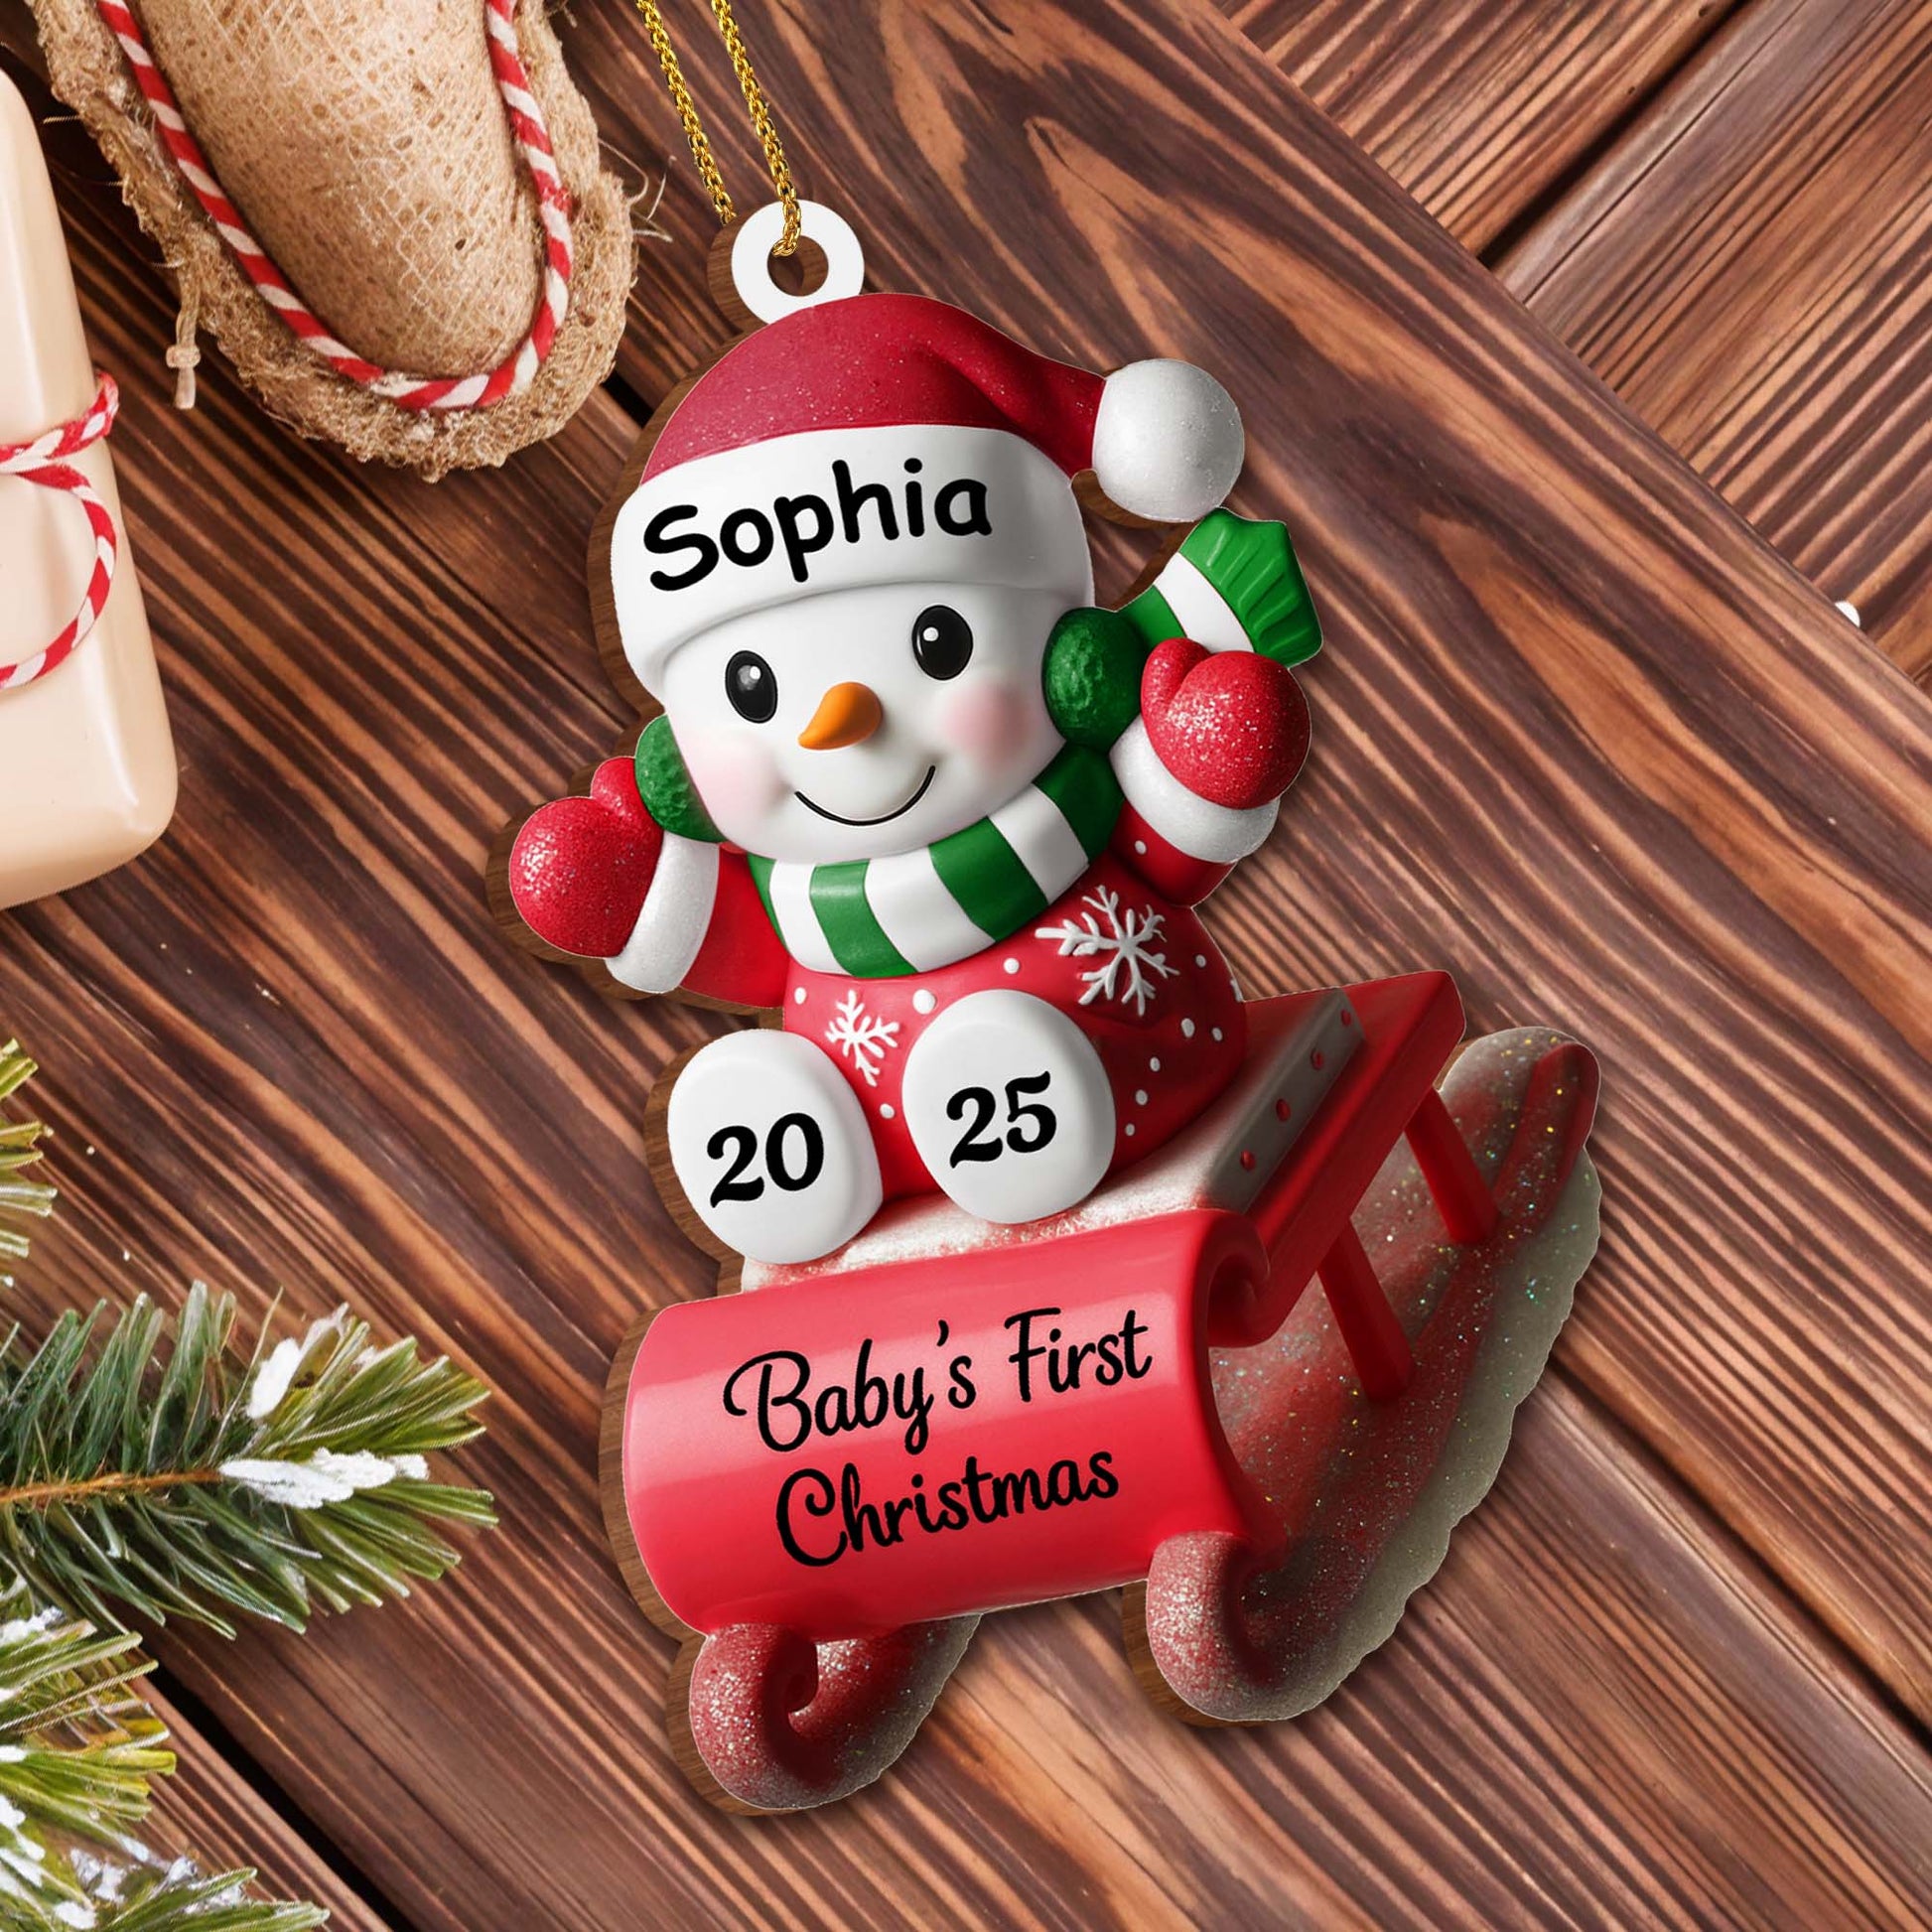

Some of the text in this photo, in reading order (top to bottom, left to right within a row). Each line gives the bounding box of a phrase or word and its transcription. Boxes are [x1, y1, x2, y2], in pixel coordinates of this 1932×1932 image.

[643, 458, 993, 592] Sophia
[707, 1112, 824, 1208] 20
[946, 1070, 1057, 1169] 25
[722, 1308, 1153, 1455] Baby's First
[775, 1450, 1119, 1567] Christmas
